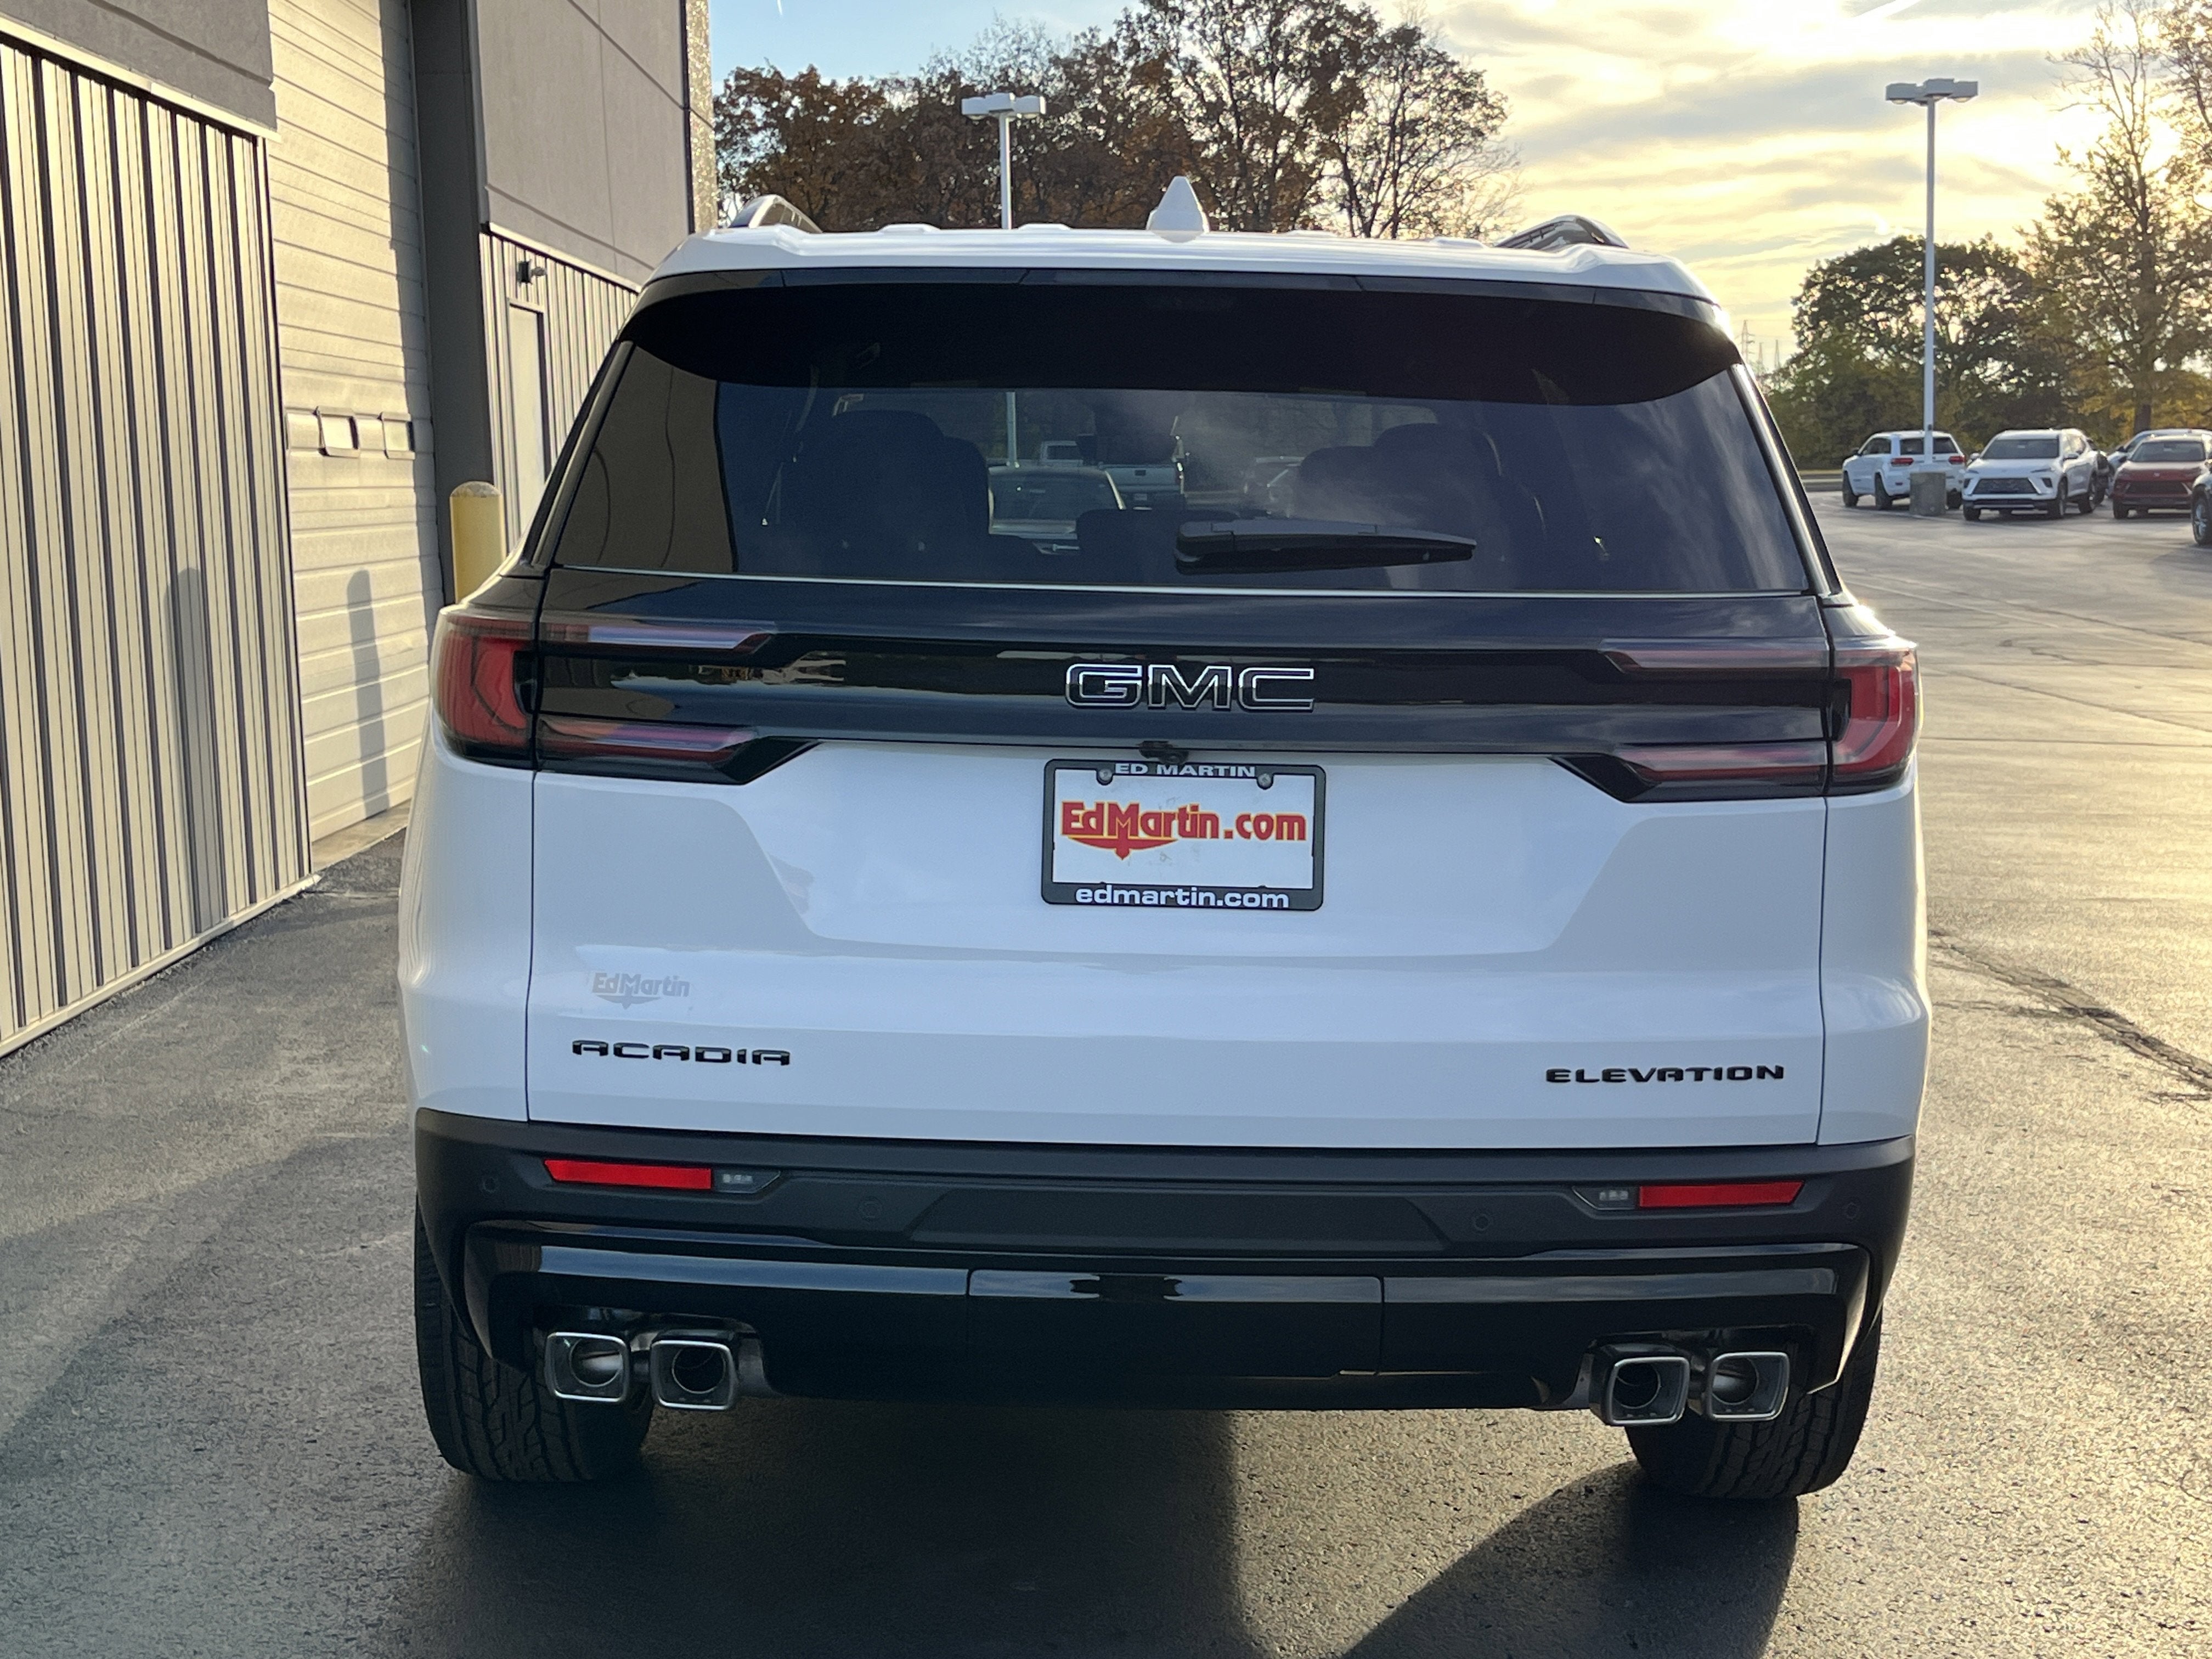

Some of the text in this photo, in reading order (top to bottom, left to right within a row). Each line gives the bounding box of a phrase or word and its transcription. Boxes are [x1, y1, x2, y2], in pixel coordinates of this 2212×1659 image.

[1065, 664, 1314, 712] GMC
[1115, 763, 1255, 777] ED MARTIN
[1075, 884, 1289, 908] edmartin.com
[592, 972, 690, 997] EdMartin
[572, 1040, 790, 1065] ACADIA
[1546, 1065, 1784, 1083] ELEVATION
